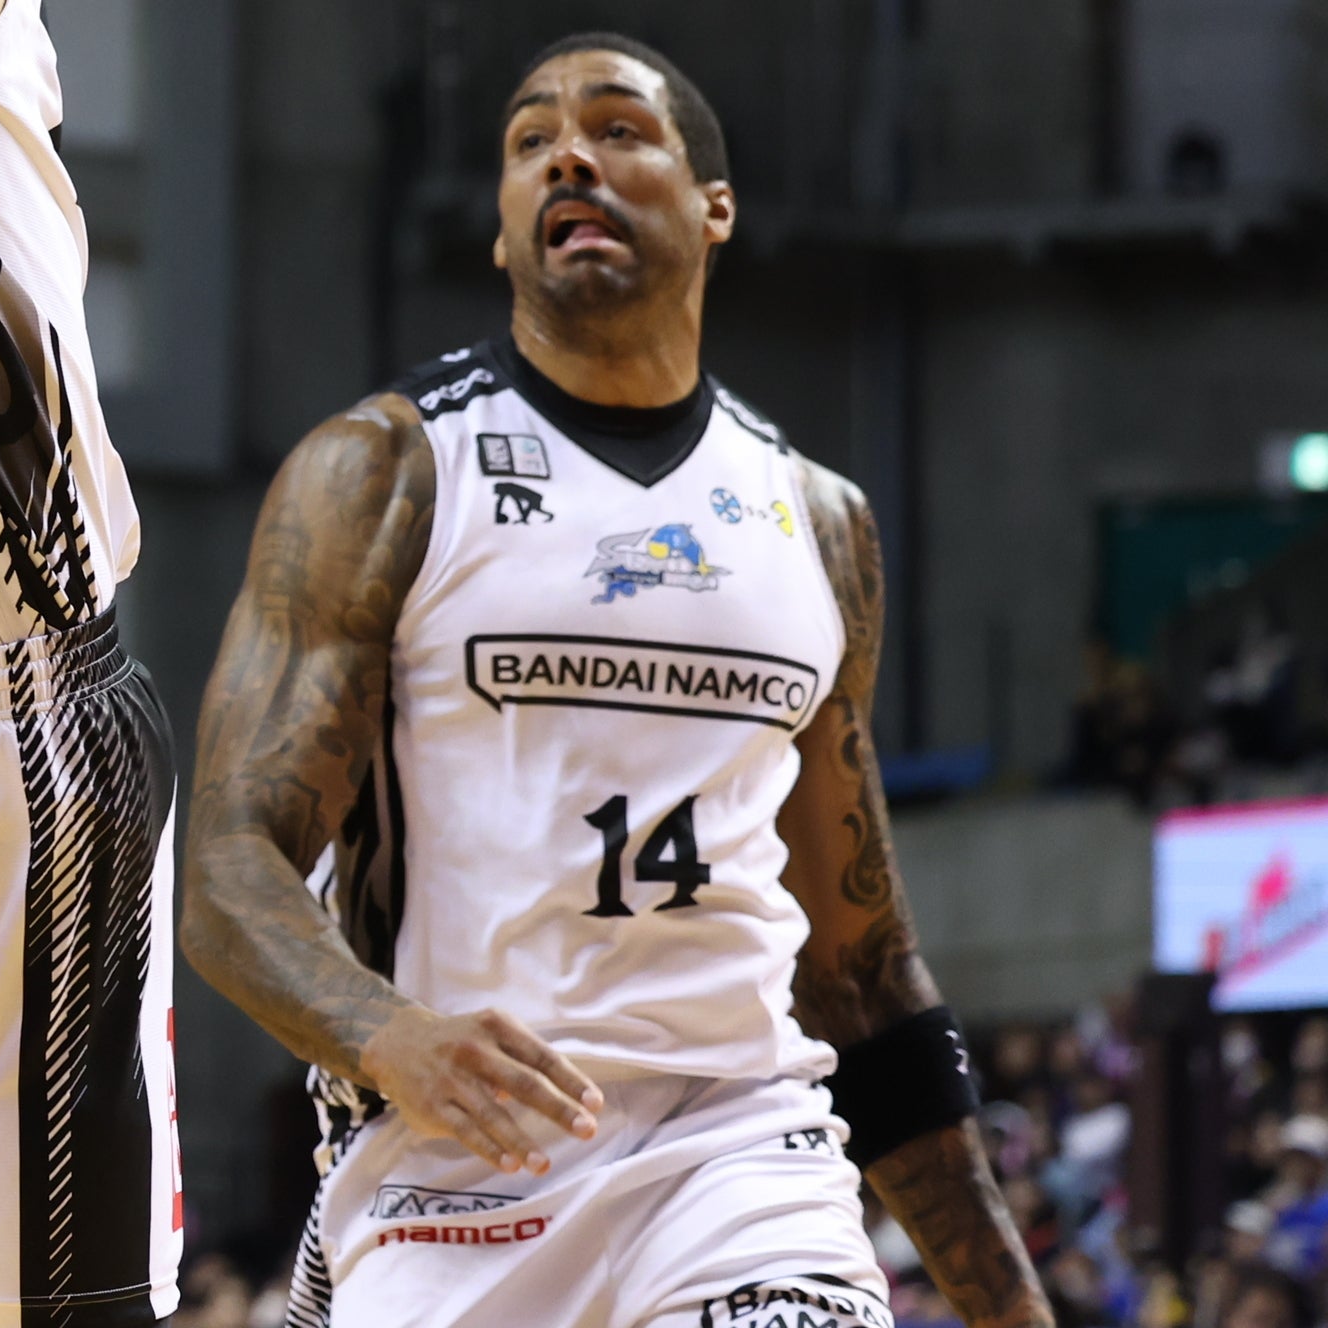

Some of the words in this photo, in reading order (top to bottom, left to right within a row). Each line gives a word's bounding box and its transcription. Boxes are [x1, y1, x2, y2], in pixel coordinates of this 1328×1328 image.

[492, 654, 656, 693] BANDAI
[666, 663, 807, 712] NAMCO
[582, 793, 711, 918] 14
[378, 1216, 547, 1247] namco
